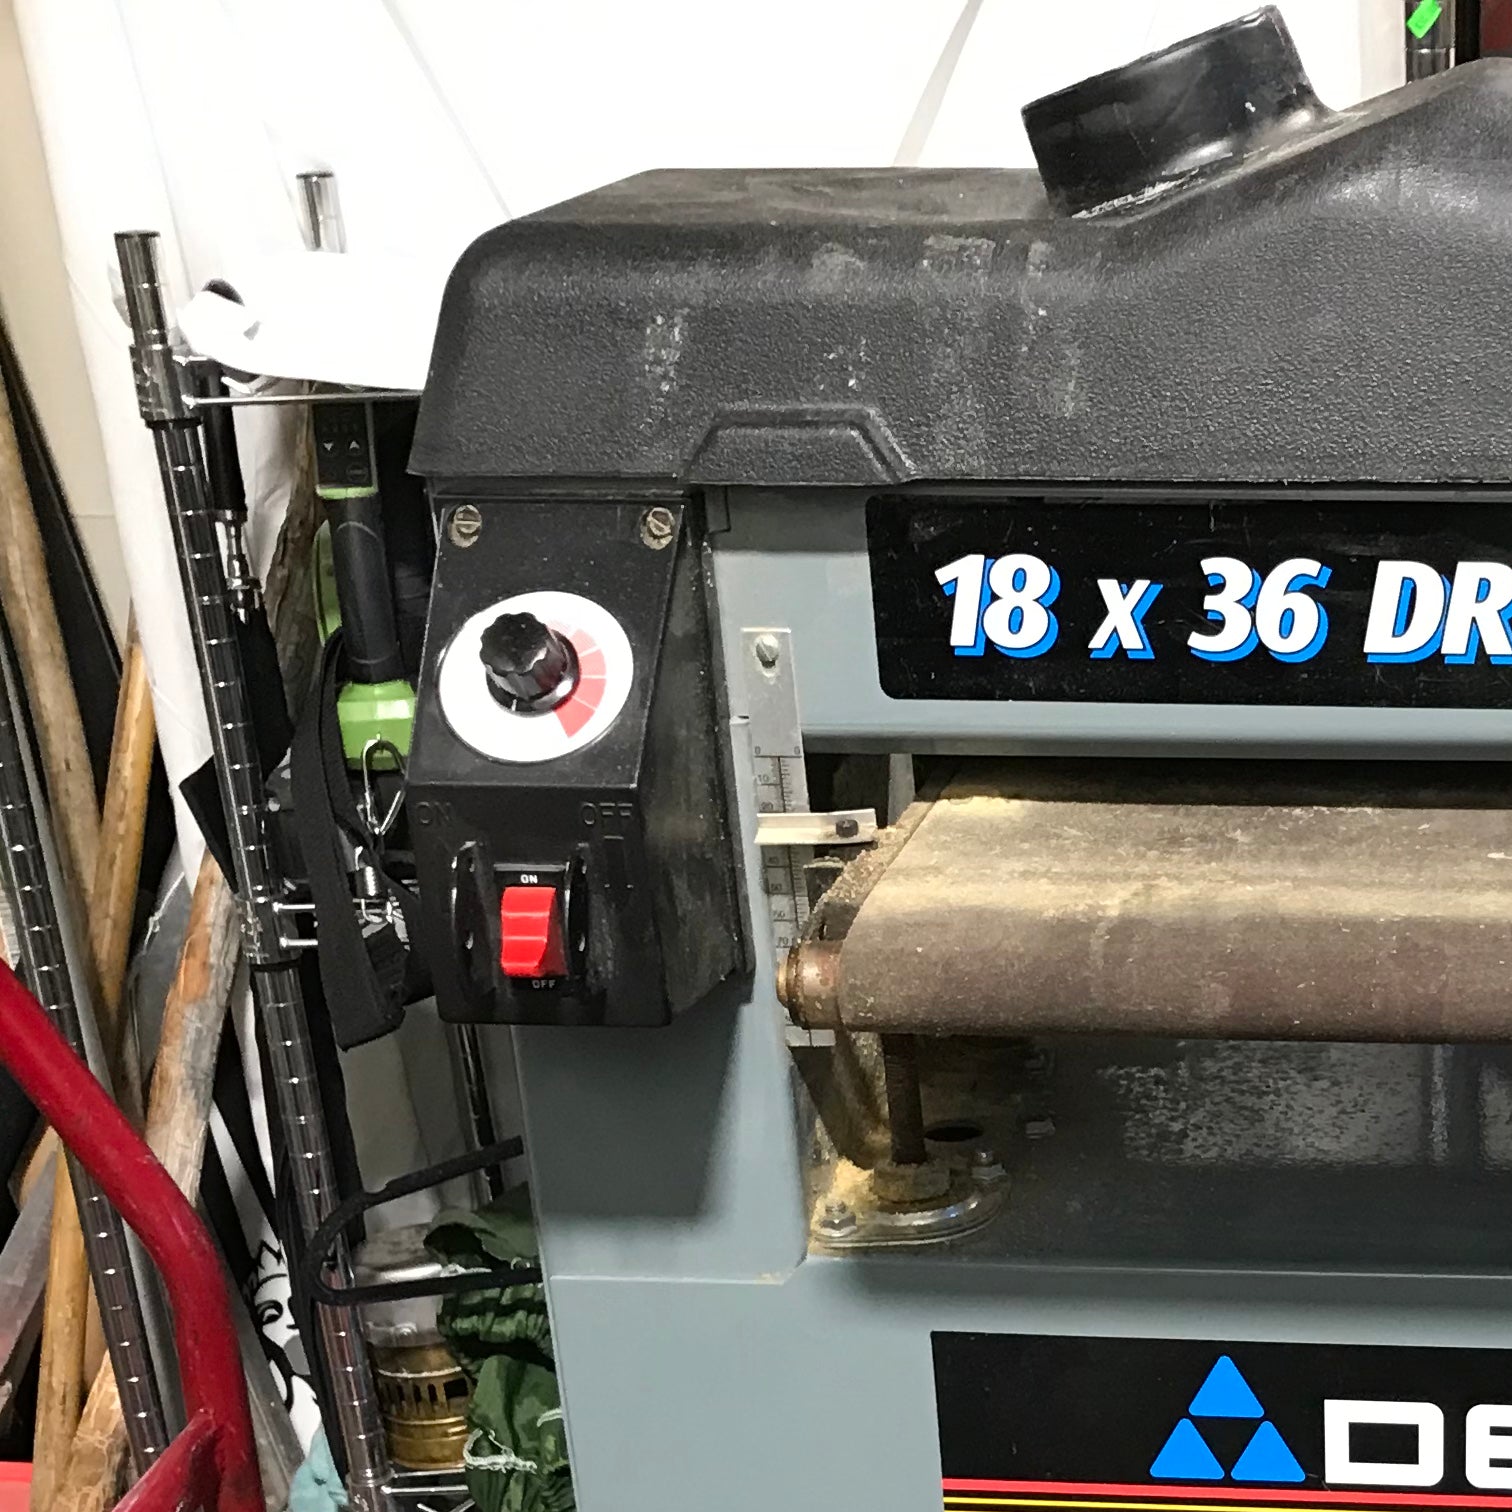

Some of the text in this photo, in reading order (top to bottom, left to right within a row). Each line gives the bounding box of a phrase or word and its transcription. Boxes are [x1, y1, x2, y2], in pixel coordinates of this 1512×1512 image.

[934, 553, 1061, 659] 18
[1187, 556, 1332, 663] 36
[581, 801, 633, 825] OFF
[520, 874, 538, 885] ON
[532, 979, 556, 989] OFF
